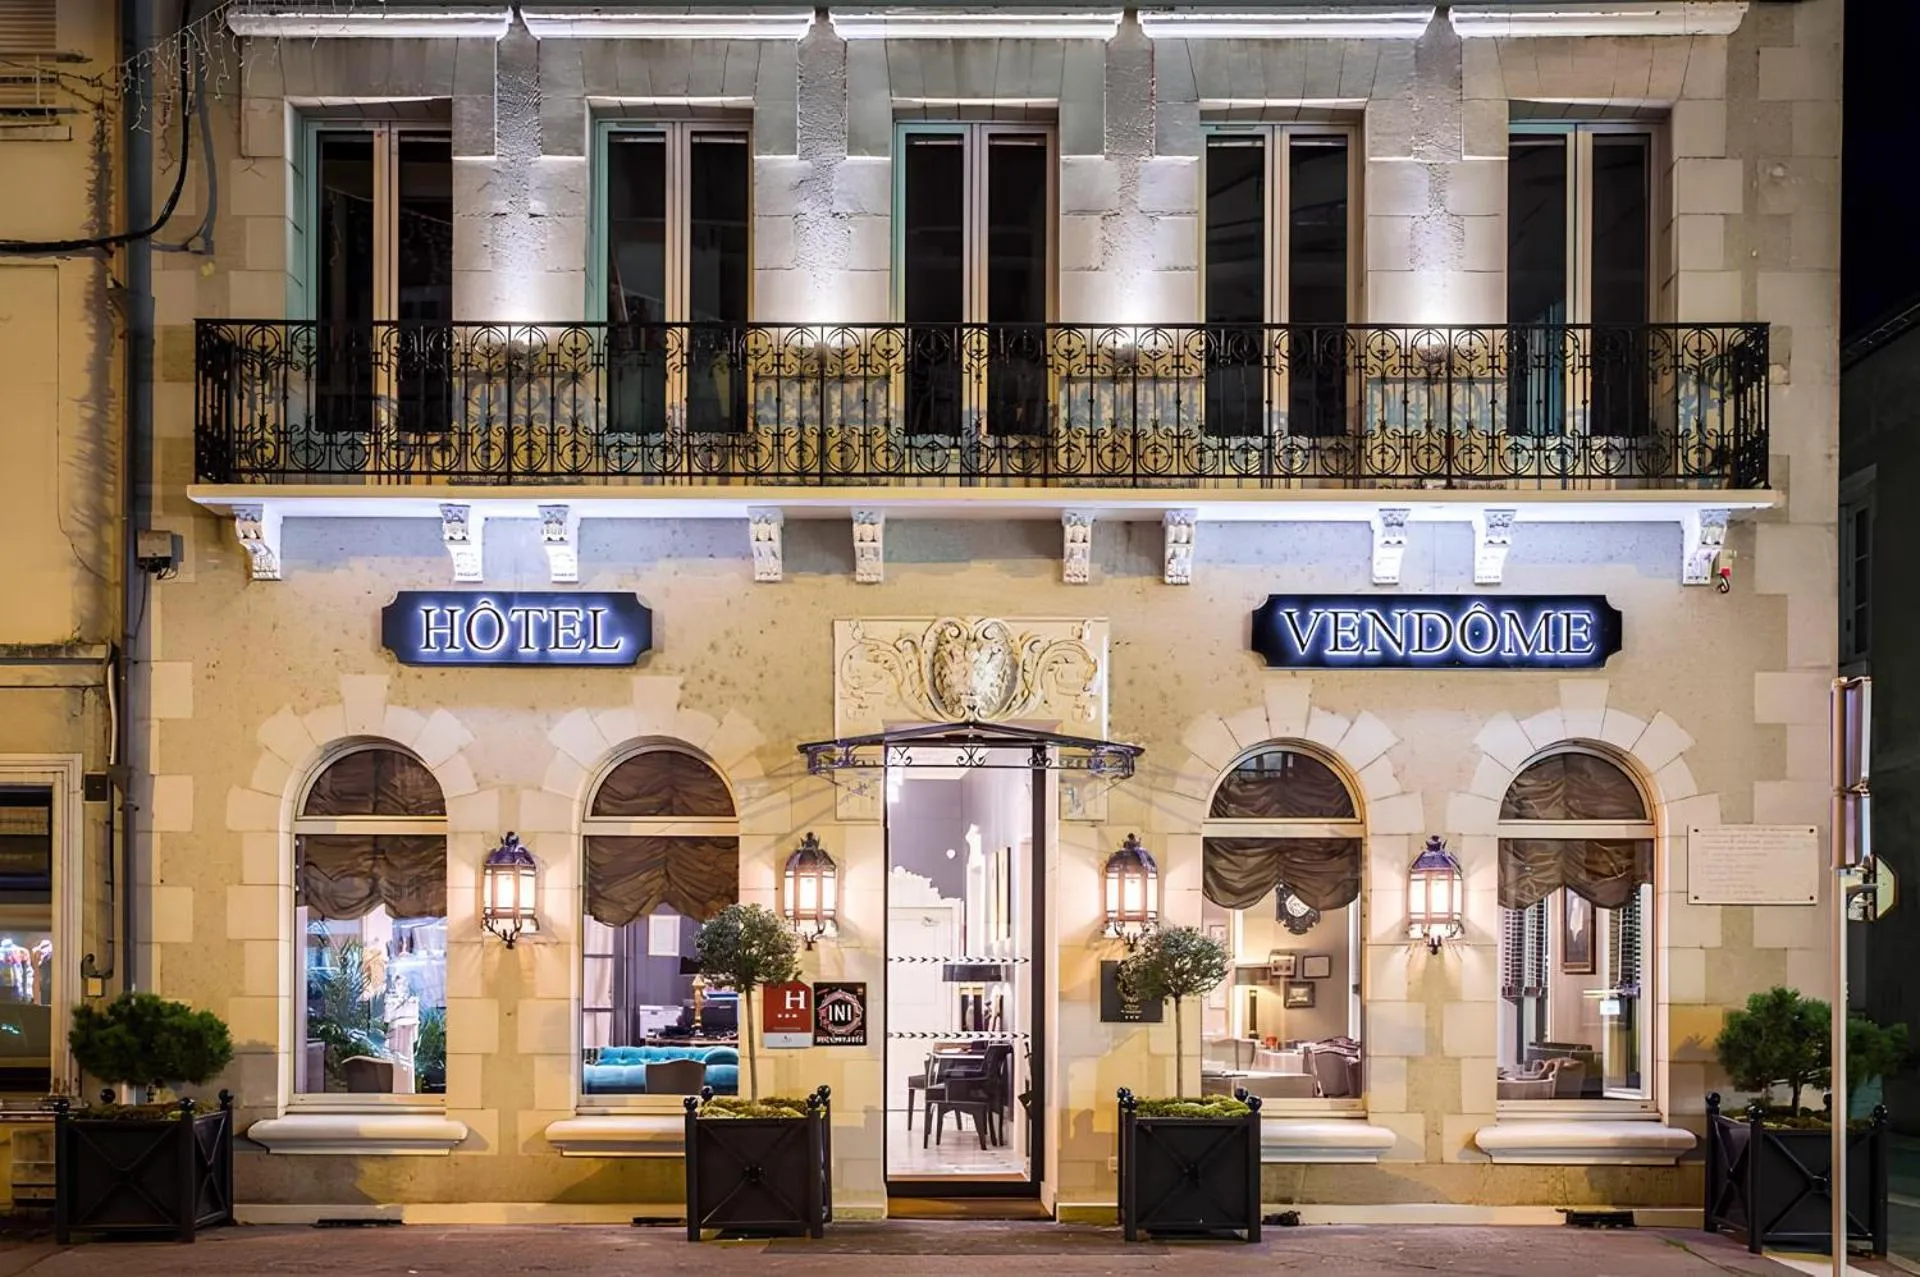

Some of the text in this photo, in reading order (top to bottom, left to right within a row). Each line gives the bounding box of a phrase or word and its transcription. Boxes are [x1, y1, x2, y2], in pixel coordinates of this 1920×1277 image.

[420, 598, 622, 653] HÔTEL
[1281, 602, 1596, 655] VENDÔME
[785, 990, 806, 1010] H
